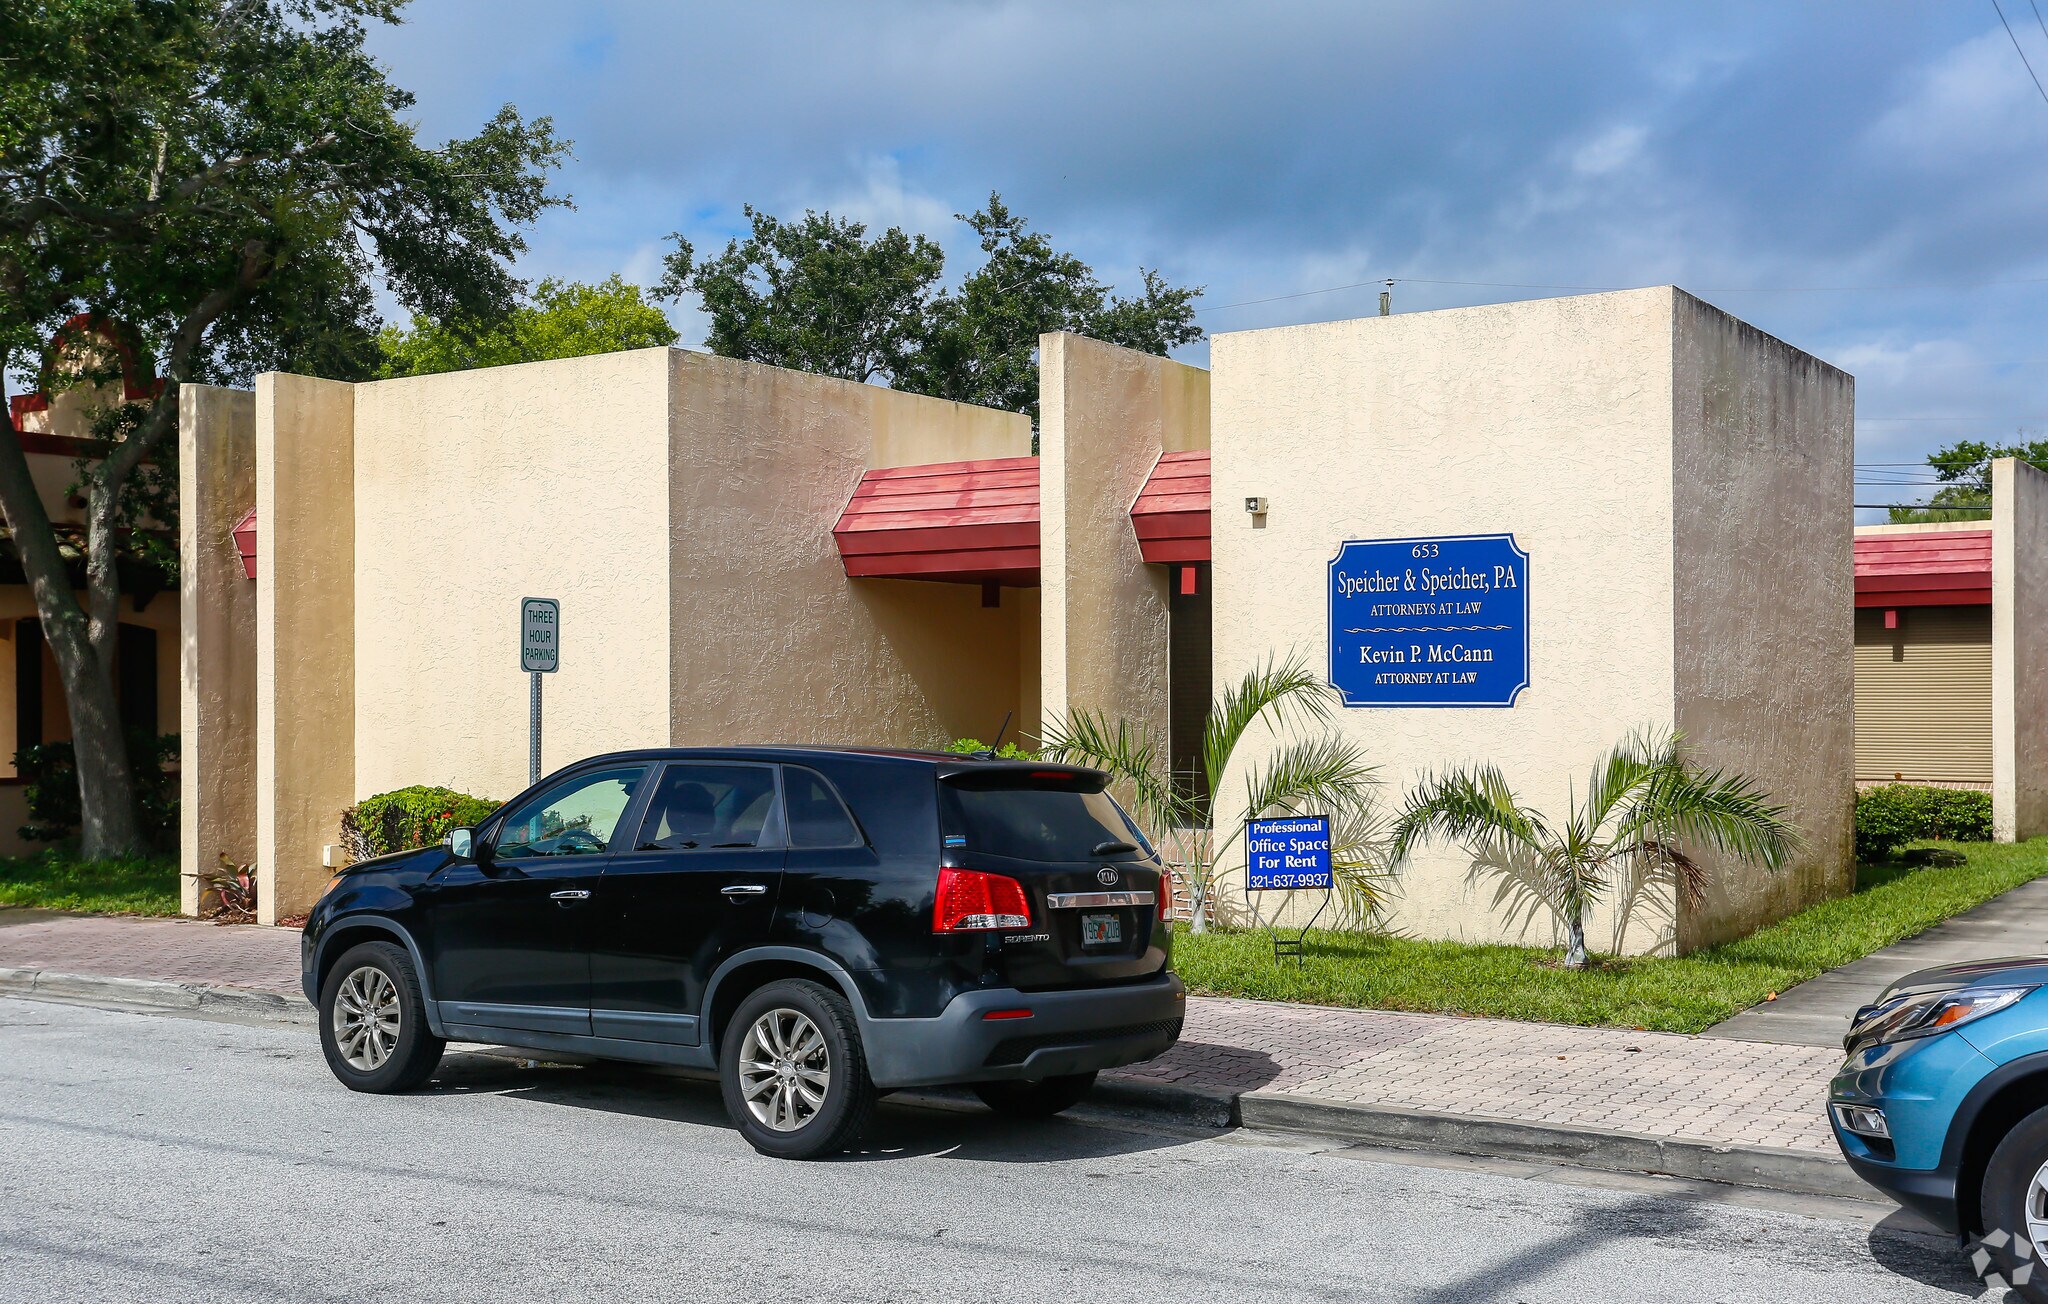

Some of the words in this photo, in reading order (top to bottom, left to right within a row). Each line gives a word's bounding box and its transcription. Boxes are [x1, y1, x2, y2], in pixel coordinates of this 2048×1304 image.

[1412, 544, 1440, 559] 653
[1337, 570, 1400, 598] Speicher
[1403, 568, 1417, 592] &
[1421, 566, 1490, 596] Speicher,
[1493, 565, 1517, 589] PA
[1370, 603, 1436, 616] ATTORNEYS
[1439, 603, 1454, 615] AT
[1456, 602, 1482, 614] LAW
[528, 610, 554, 623] THREE
[529, 629, 551, 643] HOUR
[525, 647, 555, 660] PARKING
[1359, 645, 1405, 664] Kevin
[1410, 645, 1422, 663] P.
[1427, 644, 1493, 662] McCann
[1374, 673, 1434, 684] ATTORNEY
[1434, 673, 1450, 684] AT
[1452, 672, 1477, 684] LAW
[1253, 819, 1322, 834] Professional
[1249, 838, 1286, 853] Office
[1289, 838, 1329, 855] Space
[1259, 856, 1280, 869] For
[1285, 855, 1317, 868] Rent
[1100, 871, 1116, 882] KIA
[1250, 873, 1329, 888] 321-637-9937
[1004, 934, 1050, 943] SORENTO
